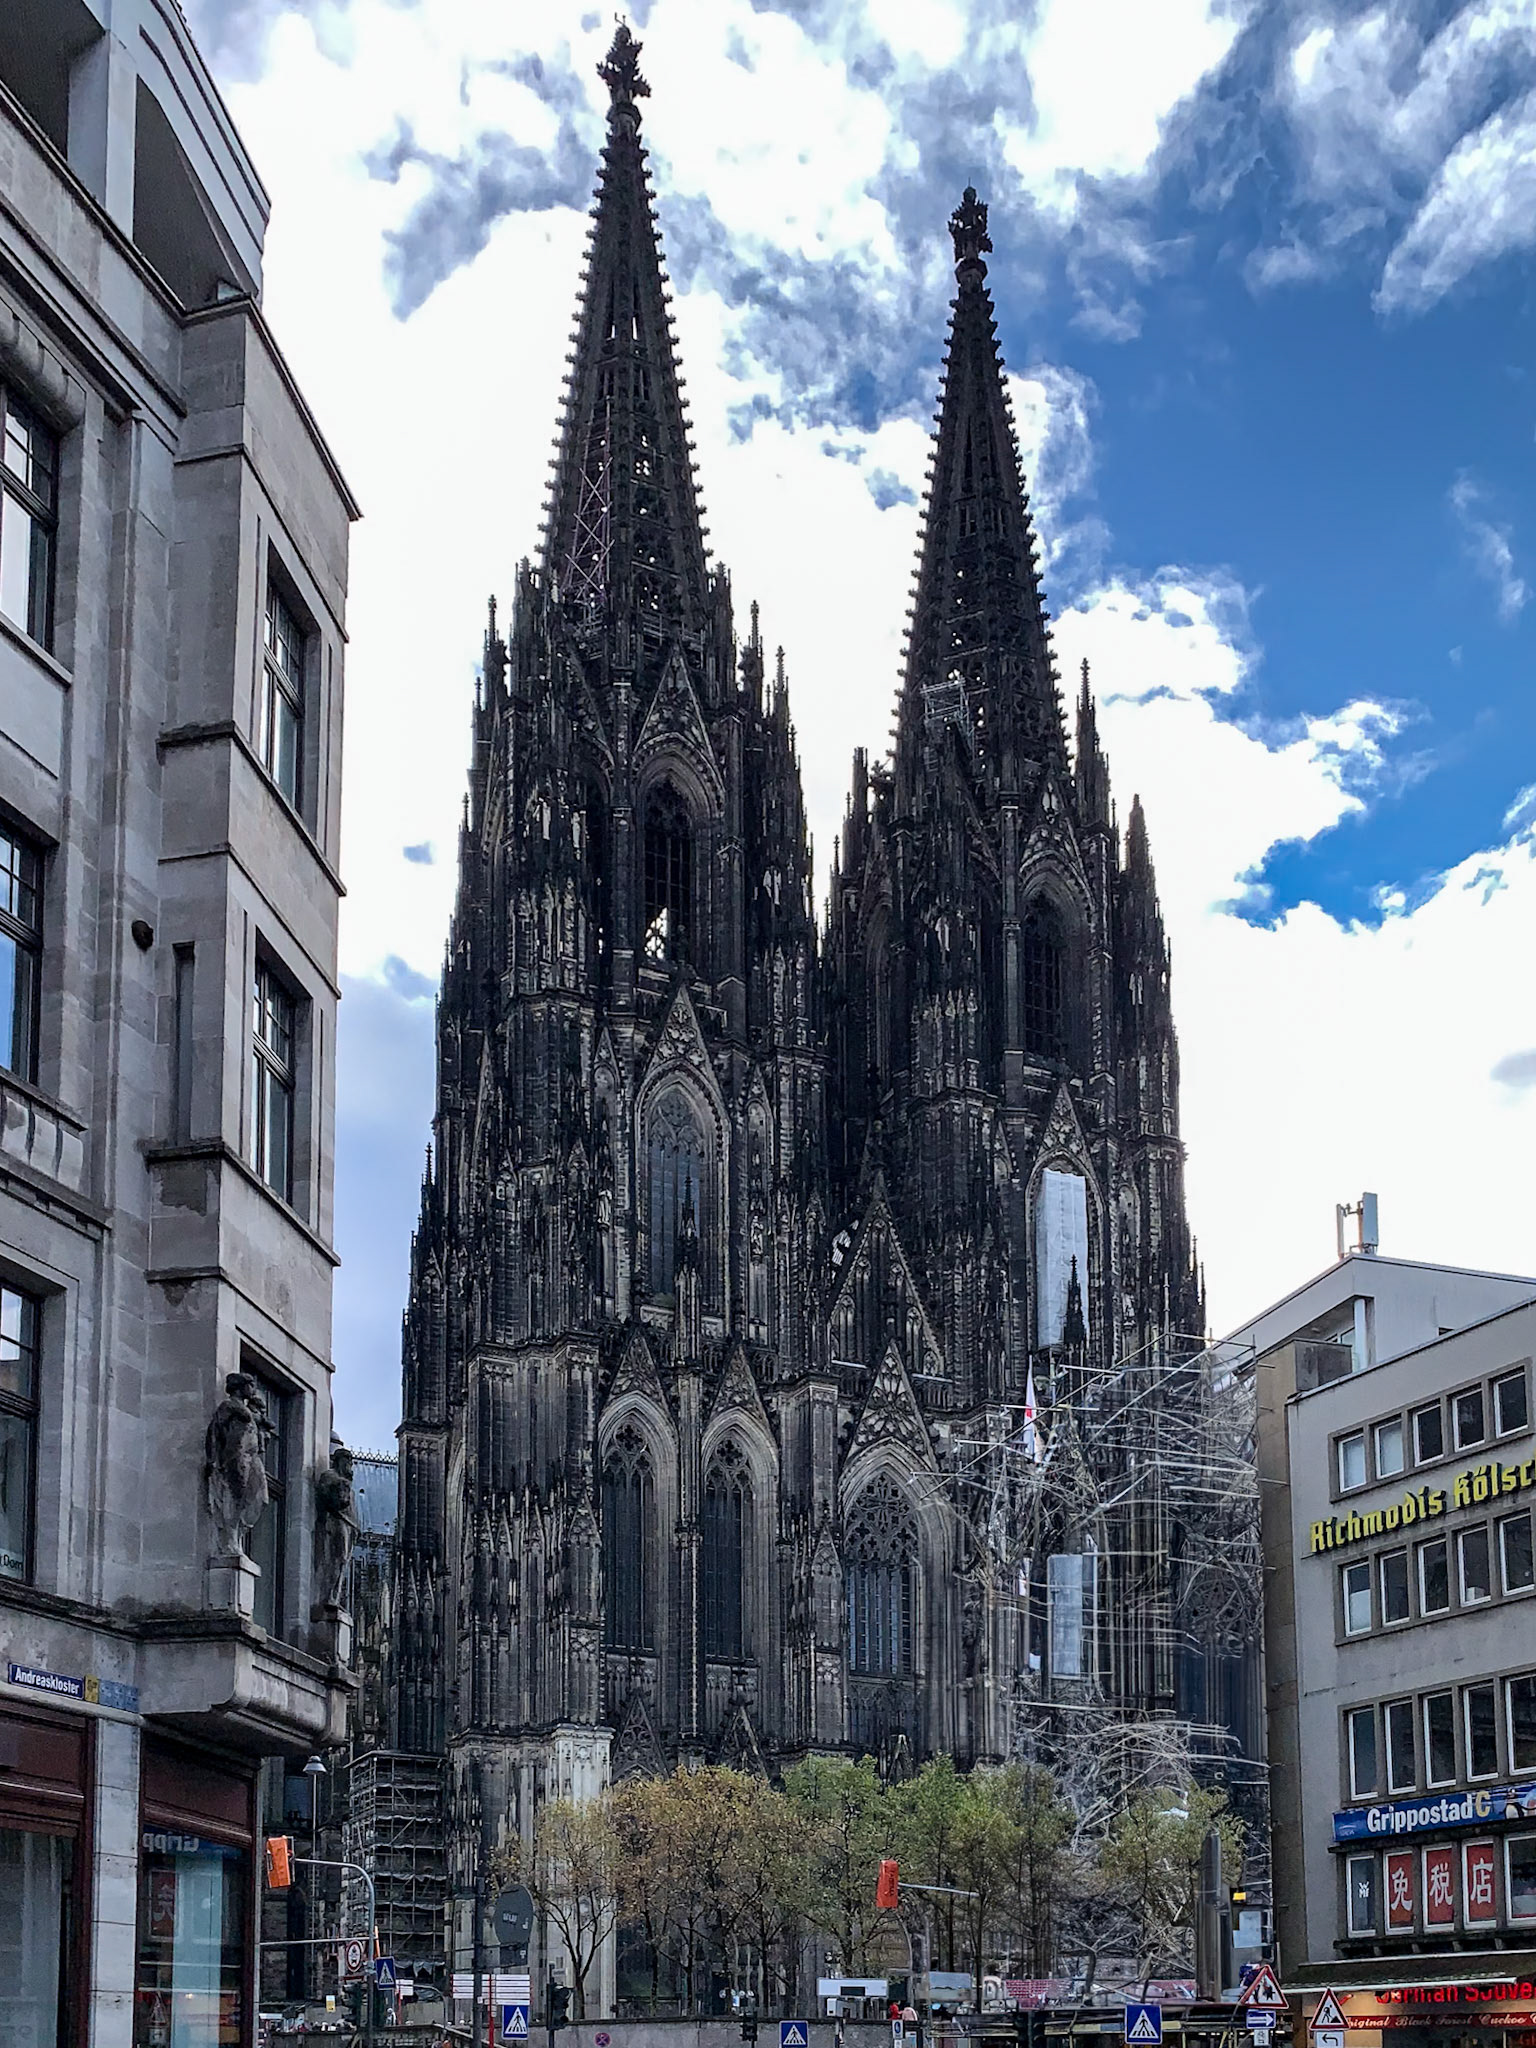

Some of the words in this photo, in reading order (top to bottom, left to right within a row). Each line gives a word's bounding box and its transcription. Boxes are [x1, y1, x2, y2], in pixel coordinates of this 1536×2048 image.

[1310, 1486, 1445, 1553] Richmodis
[1454, 1449, 1536, 1508] Kölsc
[15, 1667, 80, 1695] Andreaskloster
[1367, 1793, 1473, 1834] Grippostad
[1475, 1790, 1491, 1818] C
[1390, 1857, 1494, 1912] 免税店
[1479, 2013, 1527, 2025] Cuckoo
